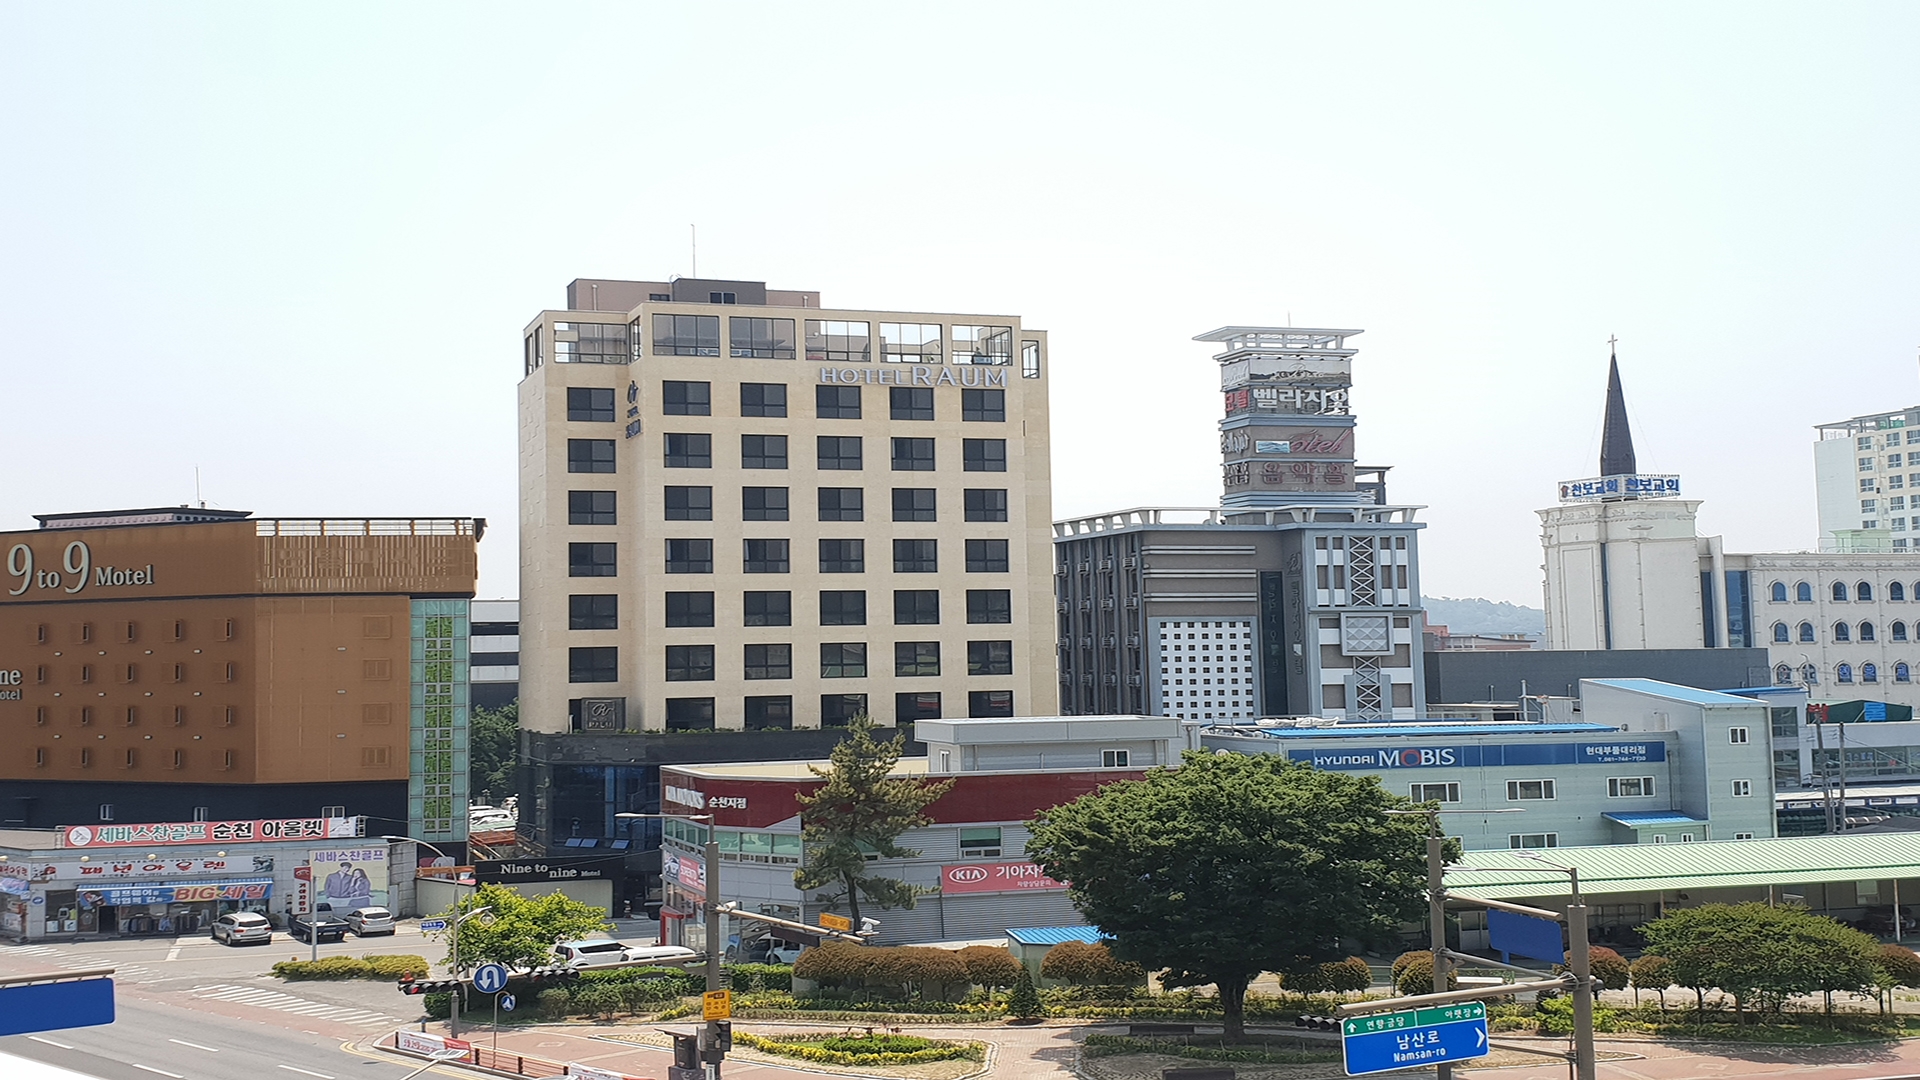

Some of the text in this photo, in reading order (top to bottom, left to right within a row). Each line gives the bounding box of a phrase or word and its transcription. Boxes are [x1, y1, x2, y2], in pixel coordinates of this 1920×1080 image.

[820, 365, 1008, 387] HOTEL RAUM
[1572, 479, 1618, 497] 천보교회
[1626, 477, 1680, 492] 천보교회
[7, 540, 154, 595] 9 to 9 Motel
[1315, 748, 1456, 767] HYUNDAI MOBIS
[709, 796, 747, 809] 순천지점
[95, 818, 323, 842] 세바스찬골프 순천 아울렛
[314, 850, 384, 862] 세바스찬골프
[500, 864, 531, 875] Nine
[534, 864, 548, 873] to
[549, 868, 578, 878] nine
[956, 870, 981, 880] KIA
[175, 885, 267, 901] BIG 세일
[1445, 1008, 1471, 1019] 아랫장
[1396, 1030, 1440, 1051] 남산로
[1393, 1048, 1446, 1063] Namsan-ro
